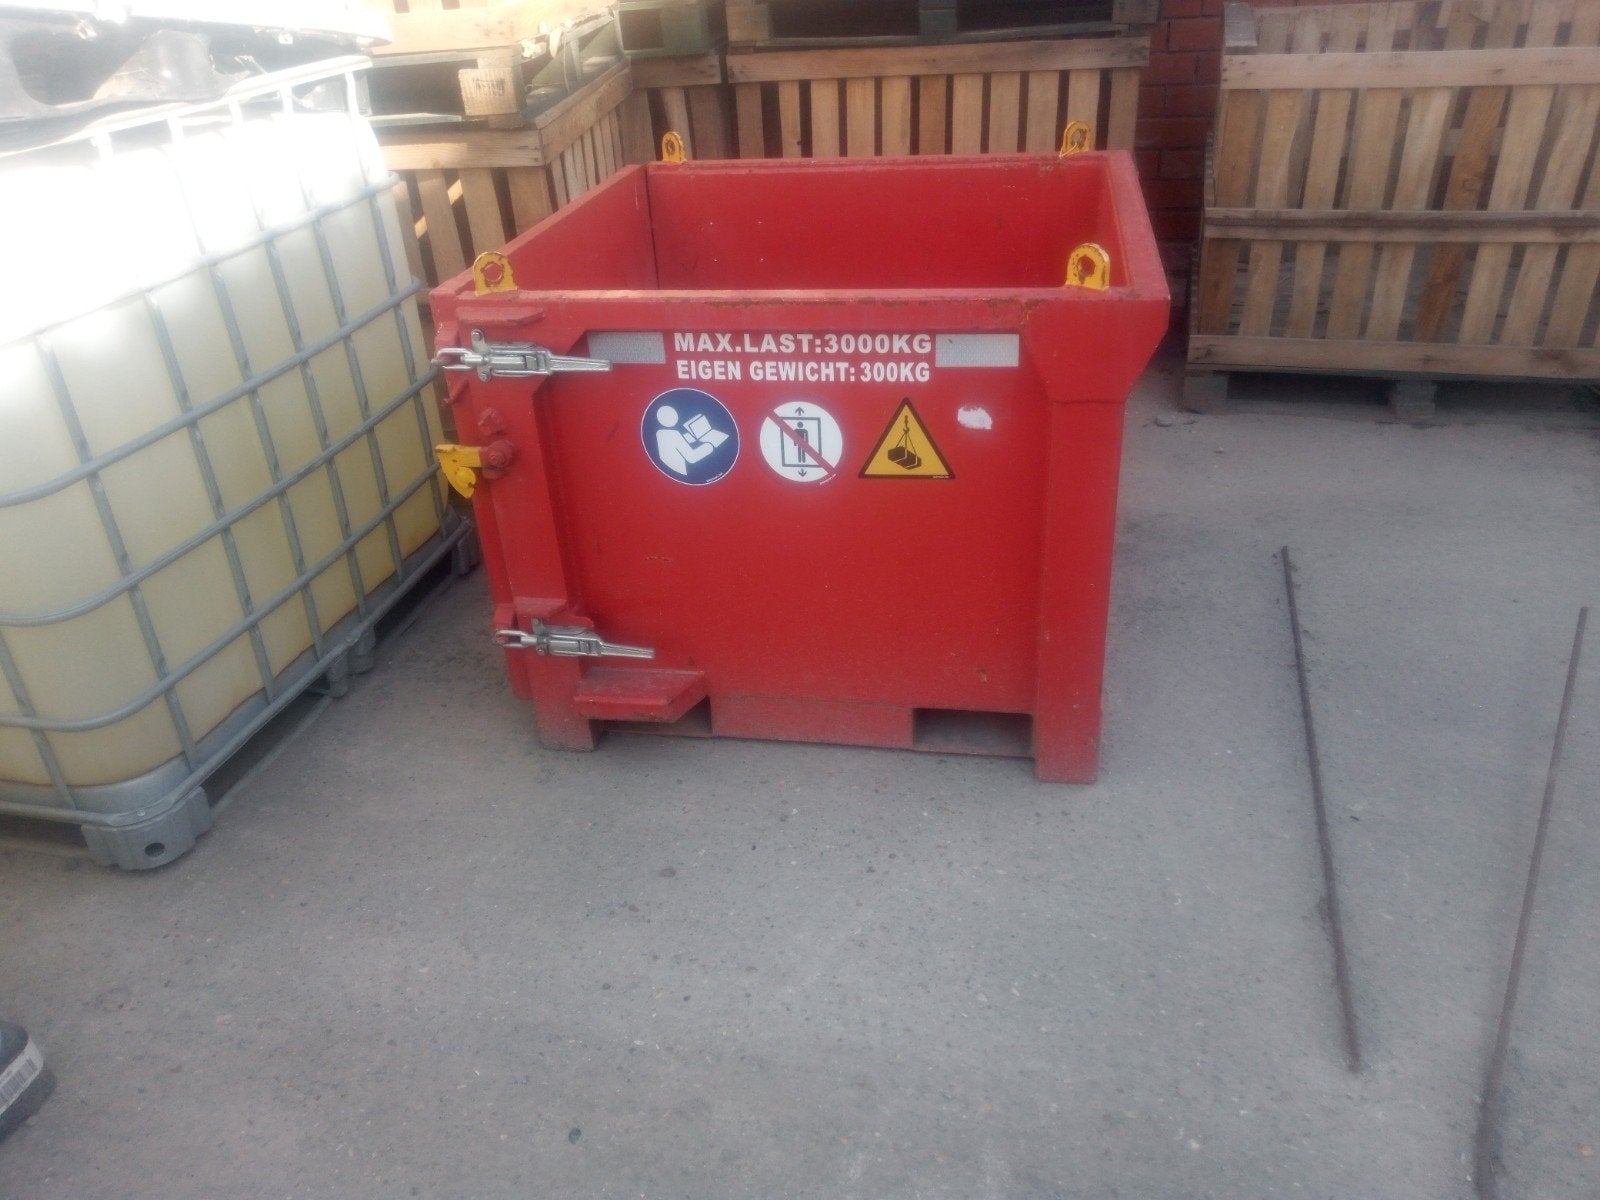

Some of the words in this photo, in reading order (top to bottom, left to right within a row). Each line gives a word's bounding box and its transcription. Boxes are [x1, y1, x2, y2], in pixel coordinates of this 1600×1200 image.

[674, 332, 932, 354] MAX.LAST:3000KG
[677, 360, 742, 380] EIGEN
[749, 361, 856, 382] GEWICHT:
[860, 362, 930, 382] 300KG
